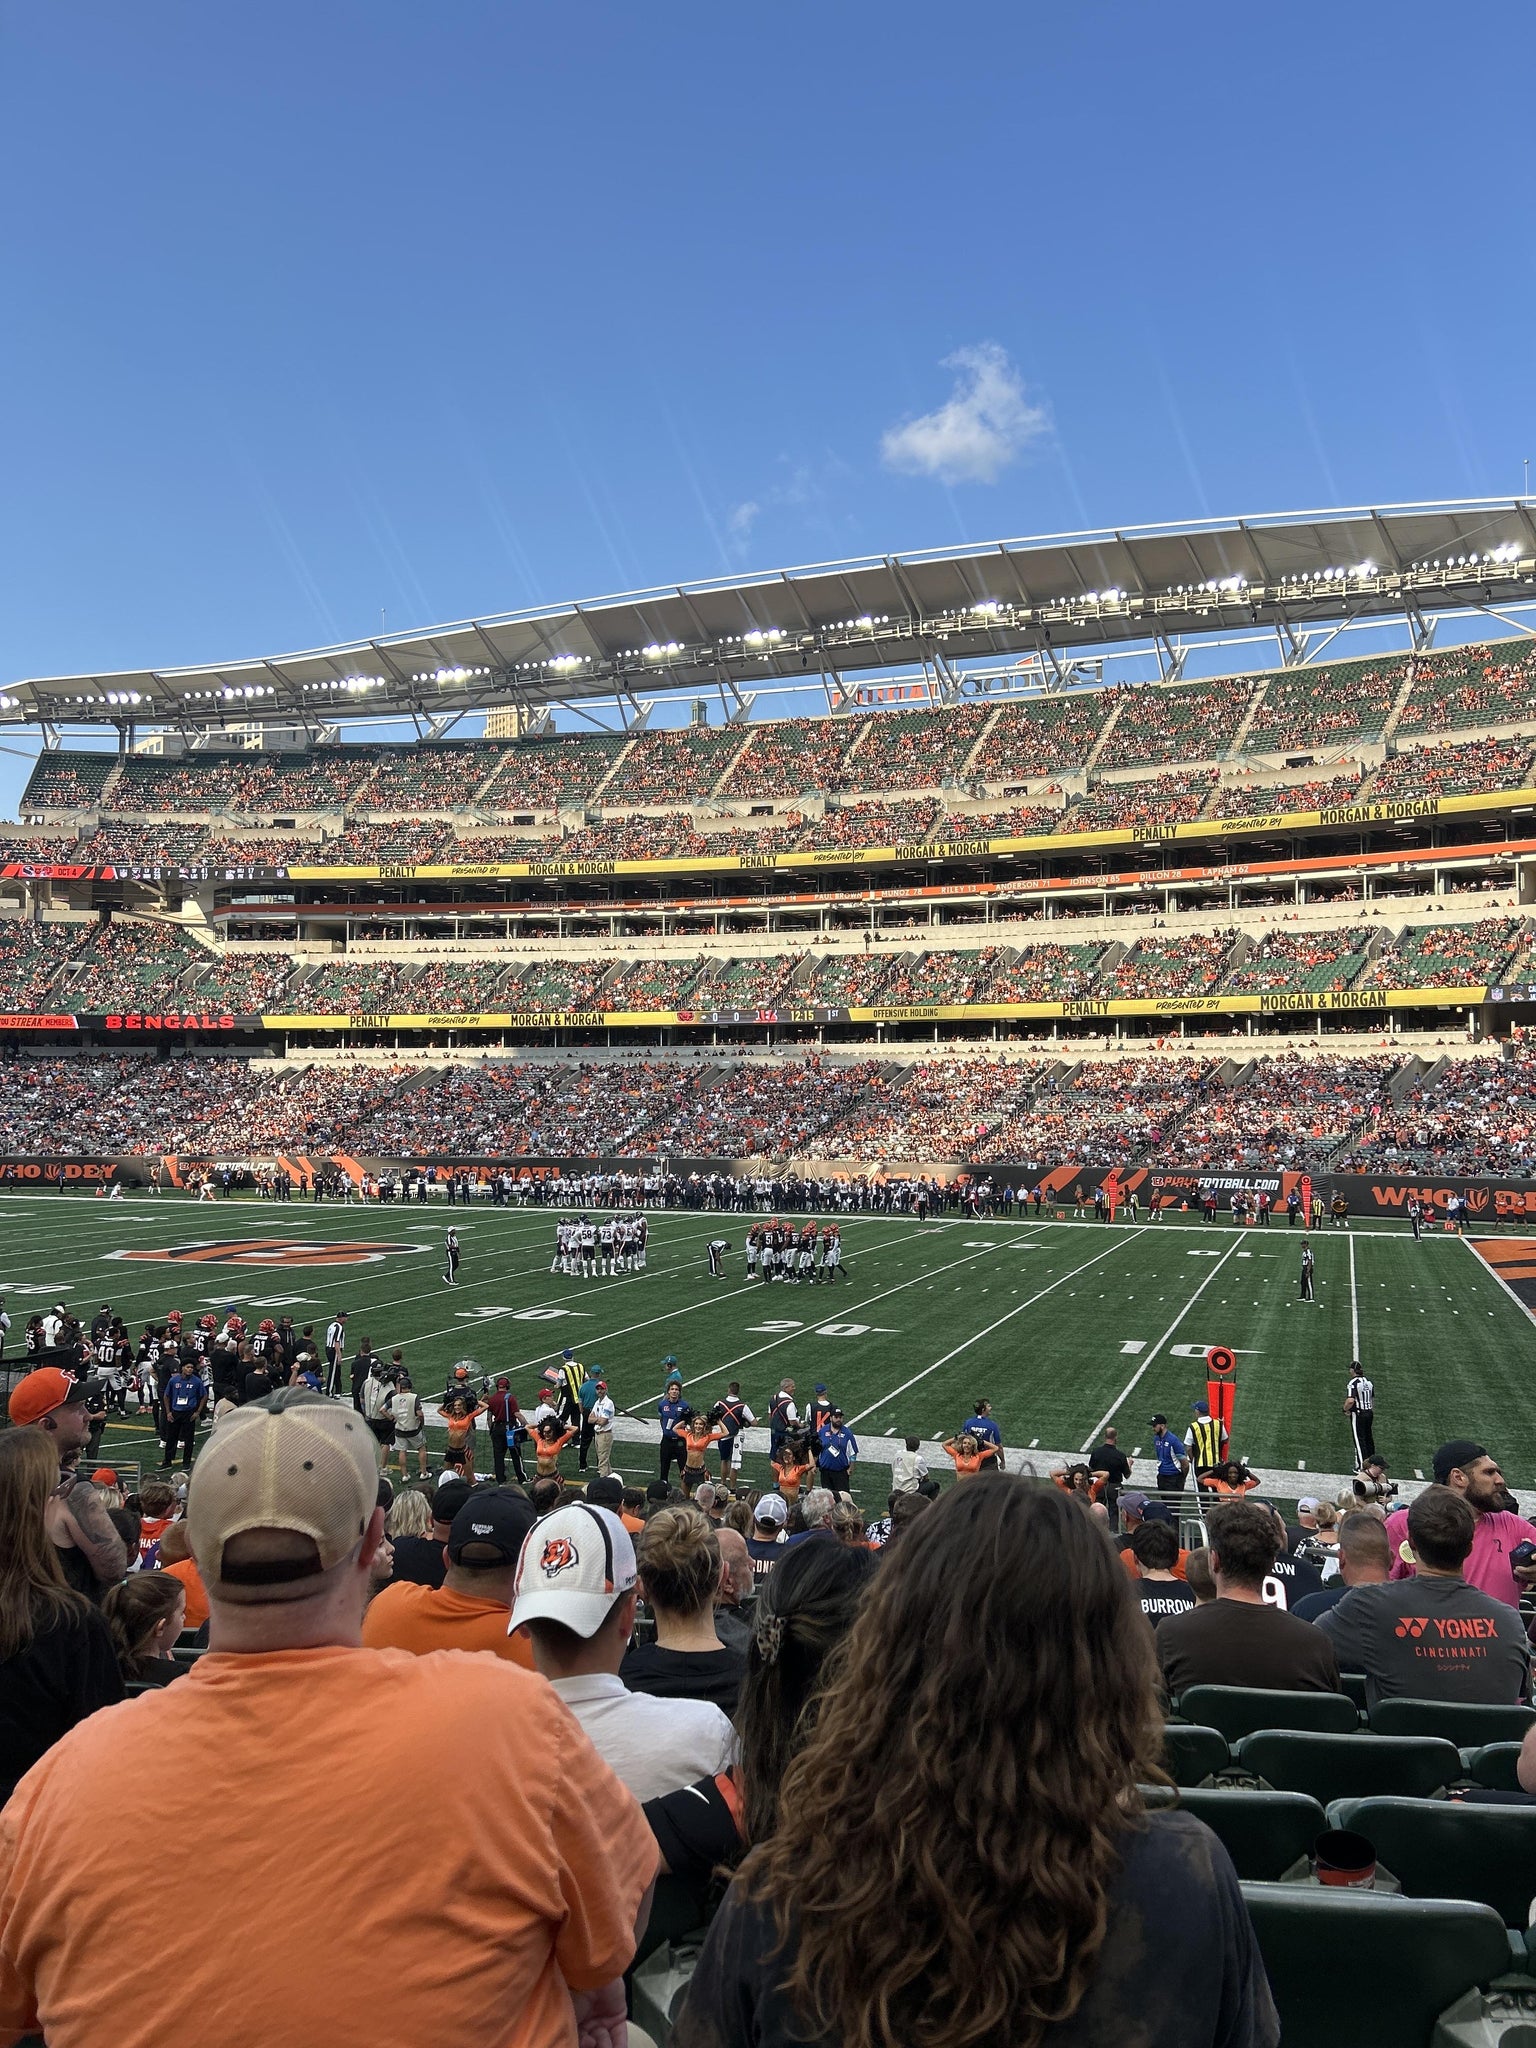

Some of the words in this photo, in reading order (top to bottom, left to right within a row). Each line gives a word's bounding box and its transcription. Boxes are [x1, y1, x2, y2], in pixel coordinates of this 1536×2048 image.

[1320, 807, 1370, 825] MORGAN
[1374, 806, 1383, 819] &
[1386, 800, 1438, 818] MORGAN
[1133, 825, 1177, 841] PENALTY
[895, 846, 936, 860] MORGAN
[938, 845, 946, 856] &
[948, 842, 989, 856] MORGAN
[740, 855, 777, 868] PENALTY
[379, 866, 416, 877] PENALTY
[528, 863, 566, 875] MORGAN
[567, 863, 575, 874] &
[577, 862, 615, 874] MORGAN
[1202, 867, 1237, 876] LAPHAM
[1238, 866, 1249, 874] 62
[1069, 876, 1109, 886] JOHNSON
[1110, 875, 1120, 883] 85
[1139, 871, 1170, 881] DILLON
[941, 886, 964, 894] RILEY
[995, 881, 1039, 891] ANDERSON
[1041, 880, 1050, 888] 71
[746, 895, 786, 903] ANDERSON
[834, 891, 862, 899] BROWN
[1062, 1001, 1109, 1015] PENALTY
[1260, 995, 1314, 1010] MORGAN
[1317, 994, 1327, 1008] &
[1331, 993, 1386, 1008] MORGAN
[712, 1012, 718, 1021] 0
[733, 1012, 739, 1021] 0
[791, 1010, 814, 1021] 12:15
[827, 1010, 839, 1020] 1ST
[873, 1009, 908, 1018] OFFENSIVE
[910, 1008, 939, 1017] HOLDING
[10, 1017, 44, 1027] STREAK
[45, 1018, 73, 1026] MEMBERS
[105, 1015, 235, 1029] BENGALS
[350, 1015, 390, 1027] PENALTY
[511, 1014, 550, 1027] MORGAN
[554, 1014, 562, 1025] &
[564, 1013, 604, 1025] MORGAN
[64, 1164, 117, 1178] DEY
[1198, 1177, 1280, 1190] FOOTBALL.COM
[1371, 1186, 1458, 1208] WHO
[582, 1229, 592, 1240] 58
[602, 1230, 612, 1240] 73
[765, 1235, 774, 1245] 51
[454, 1306, 571, 1320] 30
[744, 1320, 871, 1336] 20
[98, 1345, 115, 1362] 40
[253, 1340, 266, 1356] 91
[1119, 1340, 1217, 1358] 10
[139, 1538, 160, 1549] HAS
[1262, 1575, 1287, 1611] 9
[1140, 1598, 1194, 1615] BURROW
[1433, 1617, 1499, 1639] YONEX
[1415, 1646, 1488, 1658] CINCINNATI
